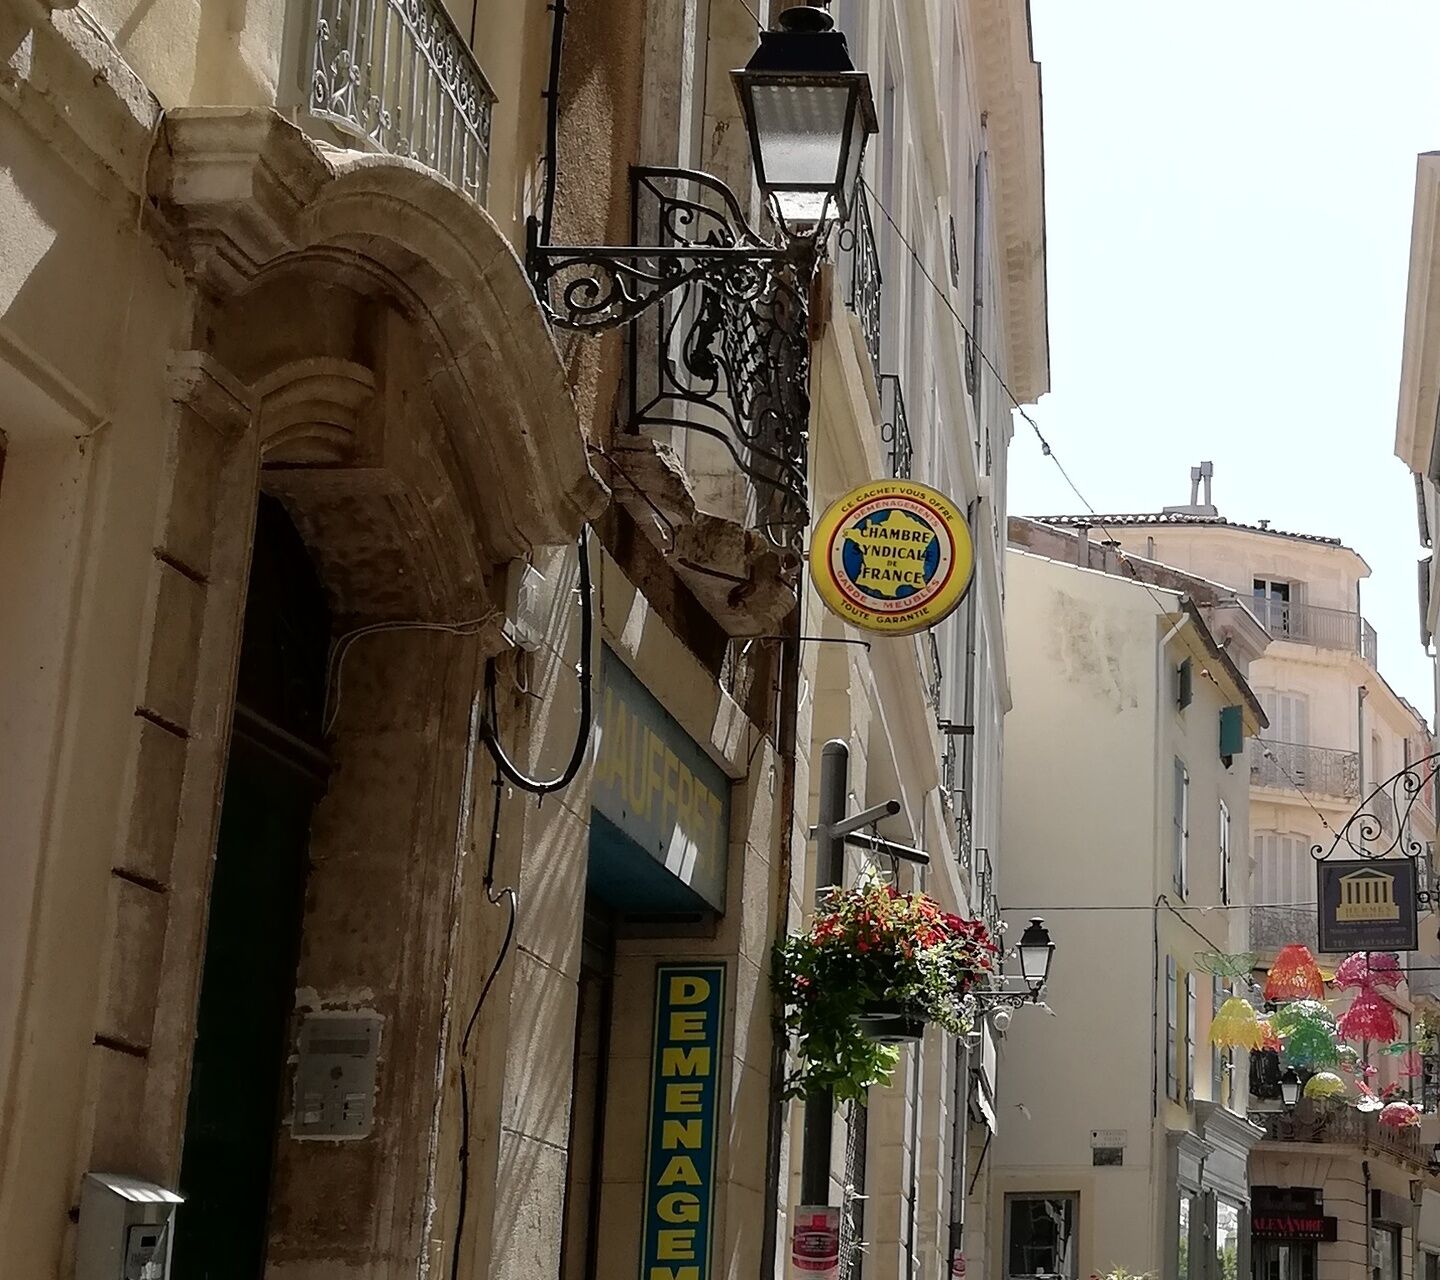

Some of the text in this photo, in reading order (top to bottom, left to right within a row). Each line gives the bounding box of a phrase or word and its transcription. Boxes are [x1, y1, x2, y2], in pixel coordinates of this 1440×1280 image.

[841, 487, 954, 522] CE CACHET VOUS OFFRE
[860, 527, 931, 544] CHAMBRE
[852, 544, 933, 562] SYNDICALE
[862, 567, 924, 584] FRANCE
[841, 599, 930, 624] TOUTE GARANTIE
